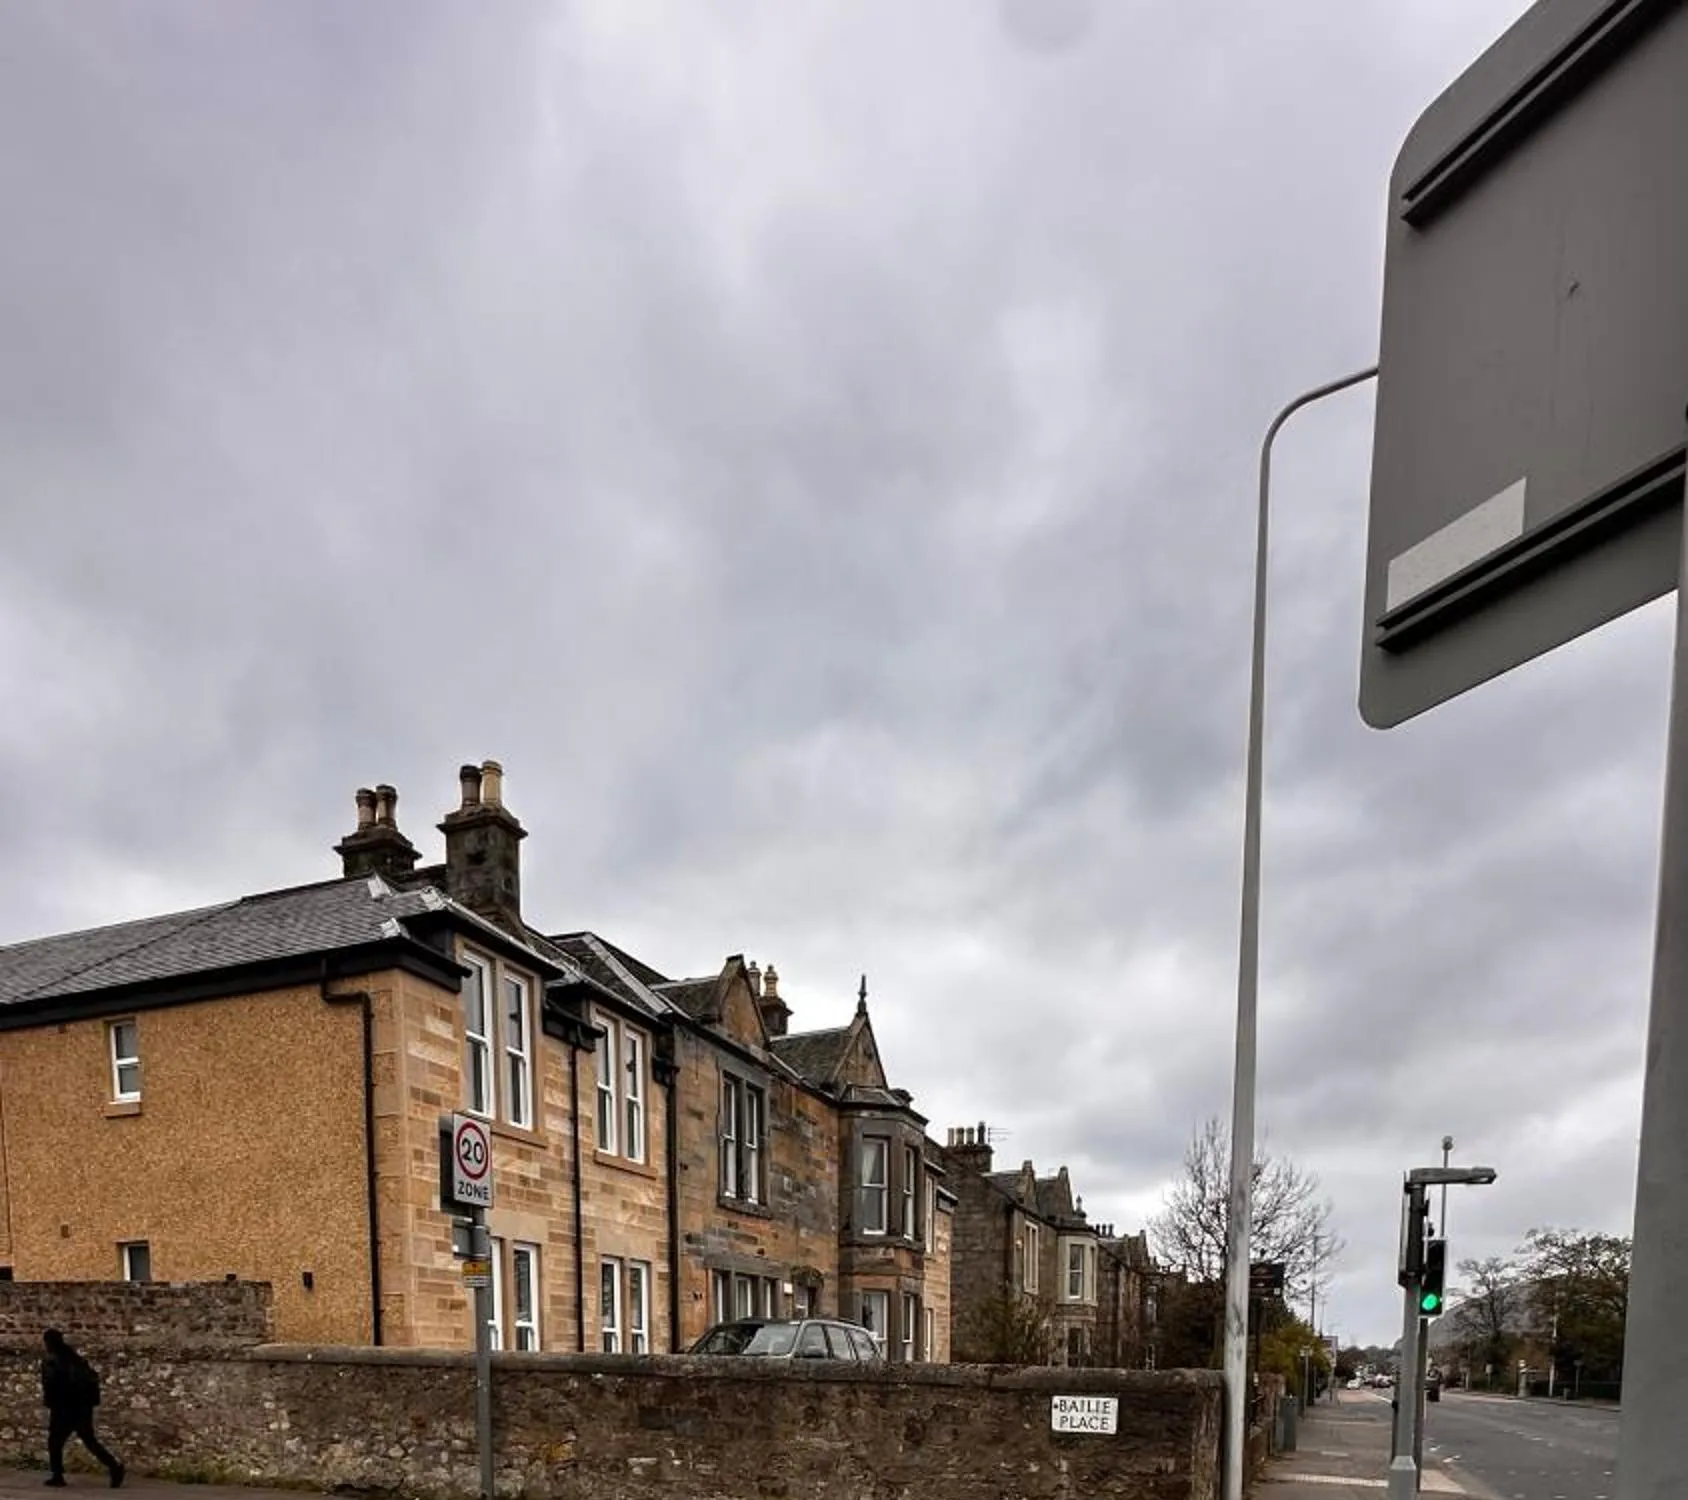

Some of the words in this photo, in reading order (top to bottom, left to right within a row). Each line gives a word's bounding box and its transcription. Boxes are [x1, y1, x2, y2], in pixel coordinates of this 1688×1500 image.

[461, 1137, 484, 1164] 20
[457, 1181, 490, 1200] ZONE
[1059, 1399, 1111, 1414] BAILIE
[1059, 1415, 1109, 1430] PLACE
